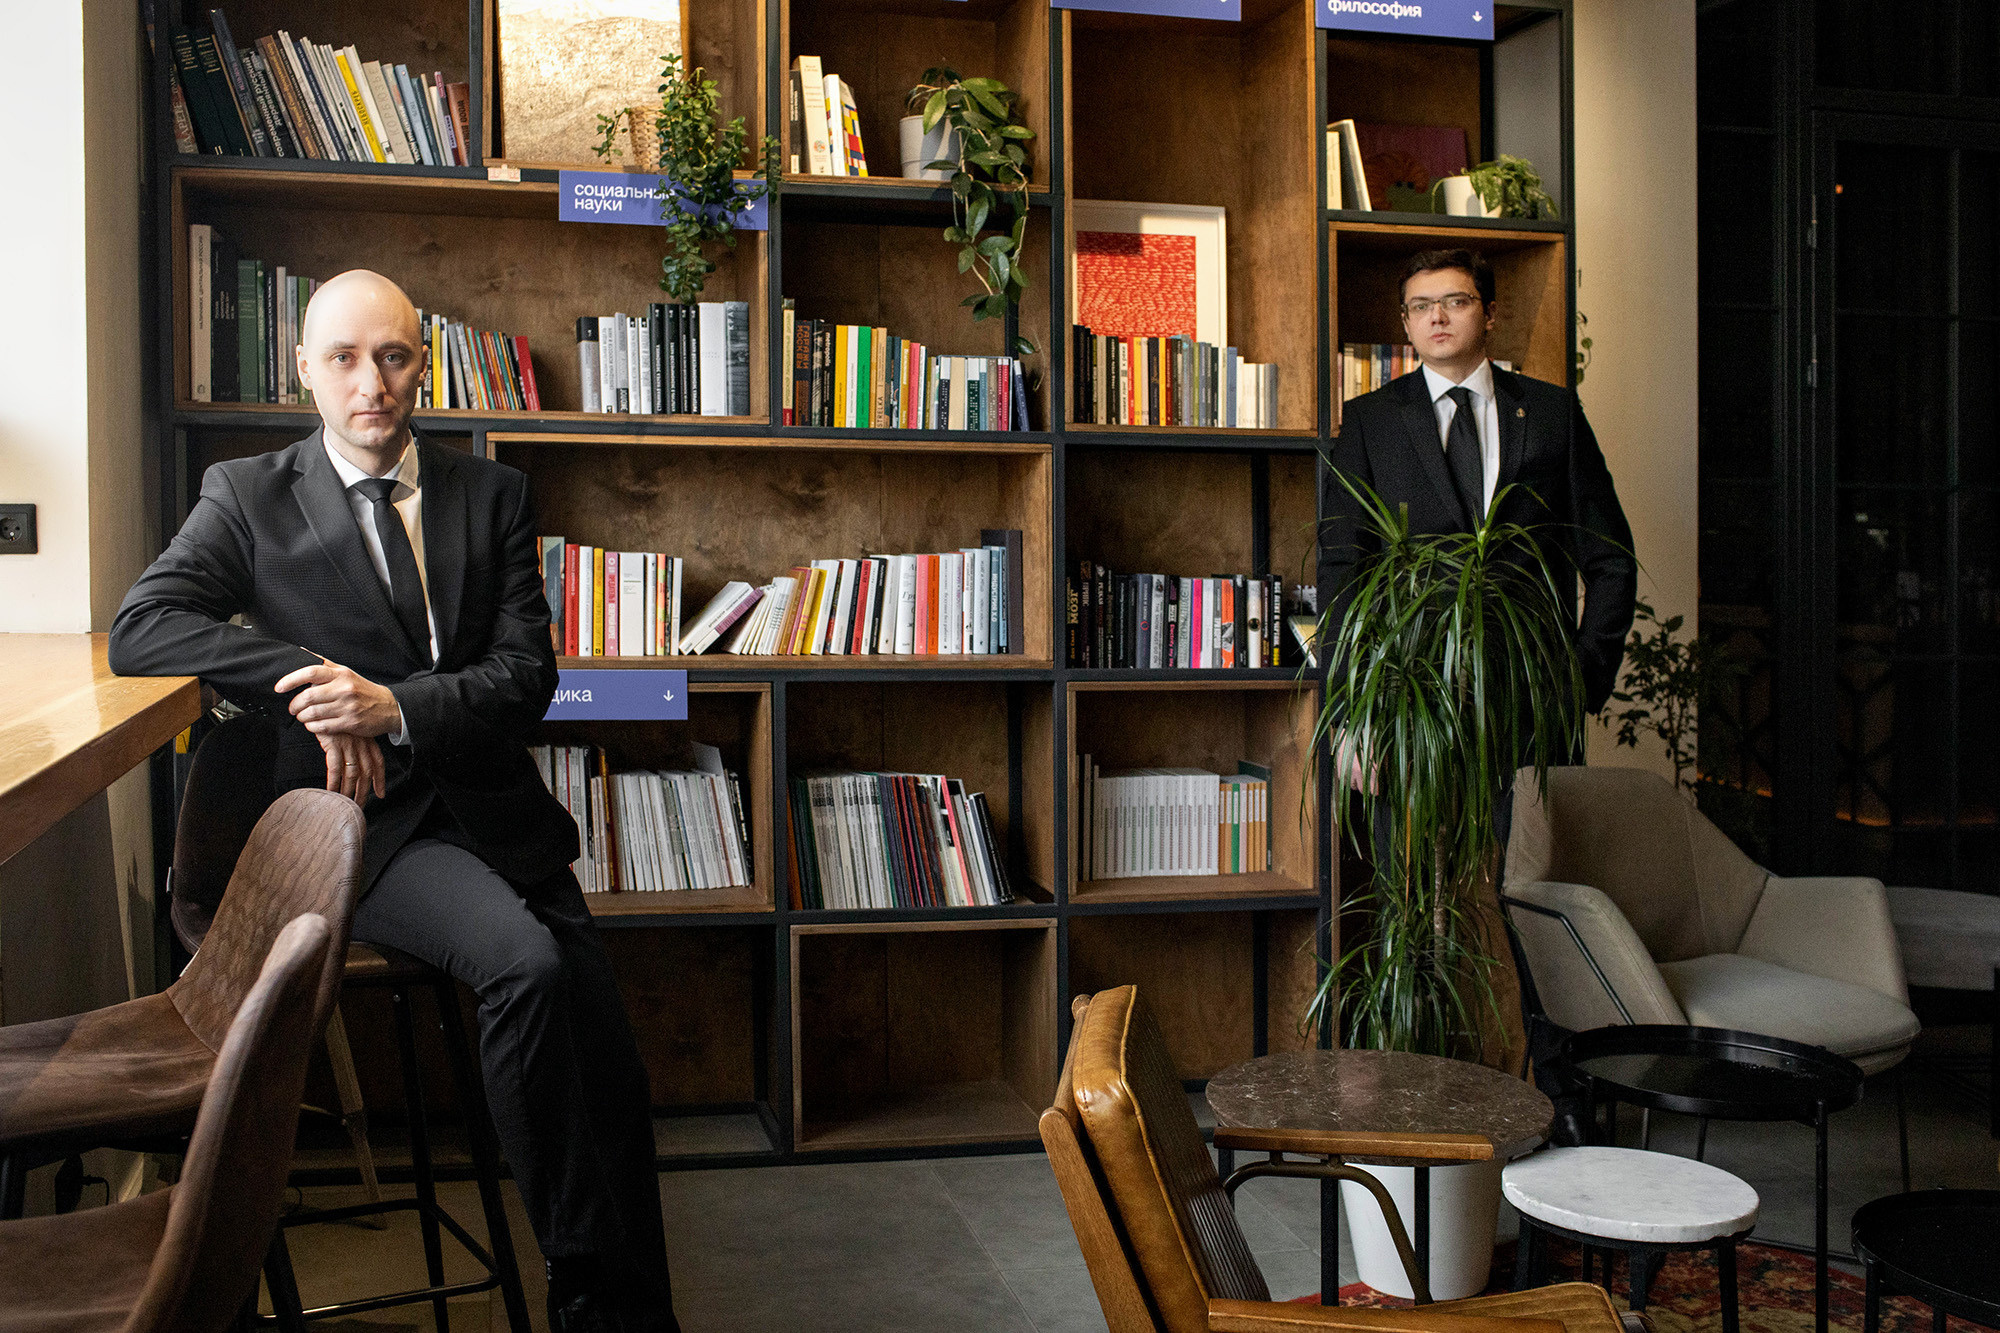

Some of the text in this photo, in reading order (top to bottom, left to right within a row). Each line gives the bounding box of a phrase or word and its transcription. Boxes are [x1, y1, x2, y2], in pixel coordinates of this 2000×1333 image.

[1328, 0, 1422, 19] философия
[575, 197, 622, 214] науки
[1070, 588, 1078, 623] МОЗГ
